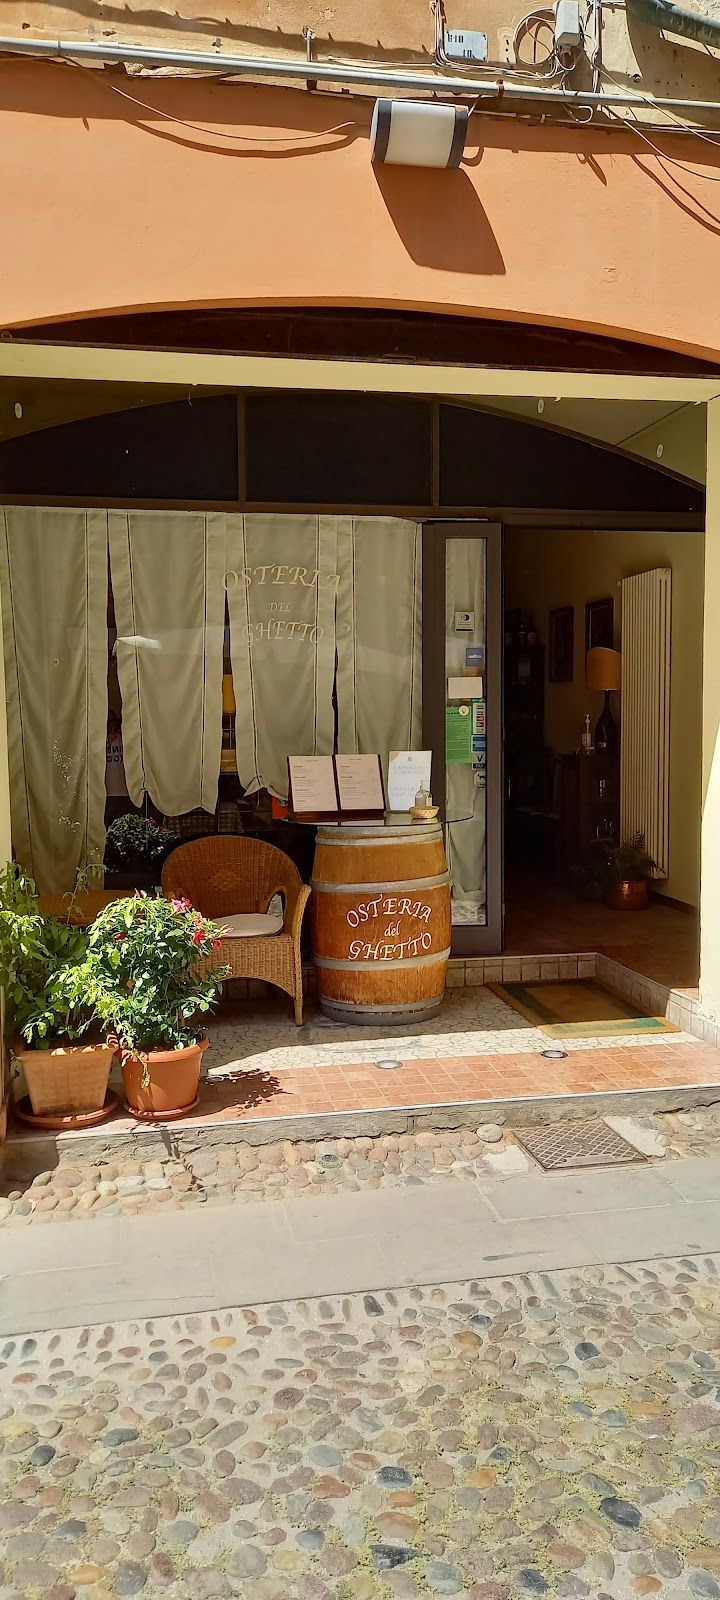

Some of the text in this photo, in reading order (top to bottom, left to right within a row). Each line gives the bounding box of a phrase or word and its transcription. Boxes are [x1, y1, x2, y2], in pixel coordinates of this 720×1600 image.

[221, 562, 341, 593] OSTERIA
[269, 602, 291, 612] DEL
[242, 618, 324, 647] GHETTO
[346, 894, 432, 928] OSTERIA
[384, 920, 401, 937] del
[348, 932, 432, 960] GHETTO
